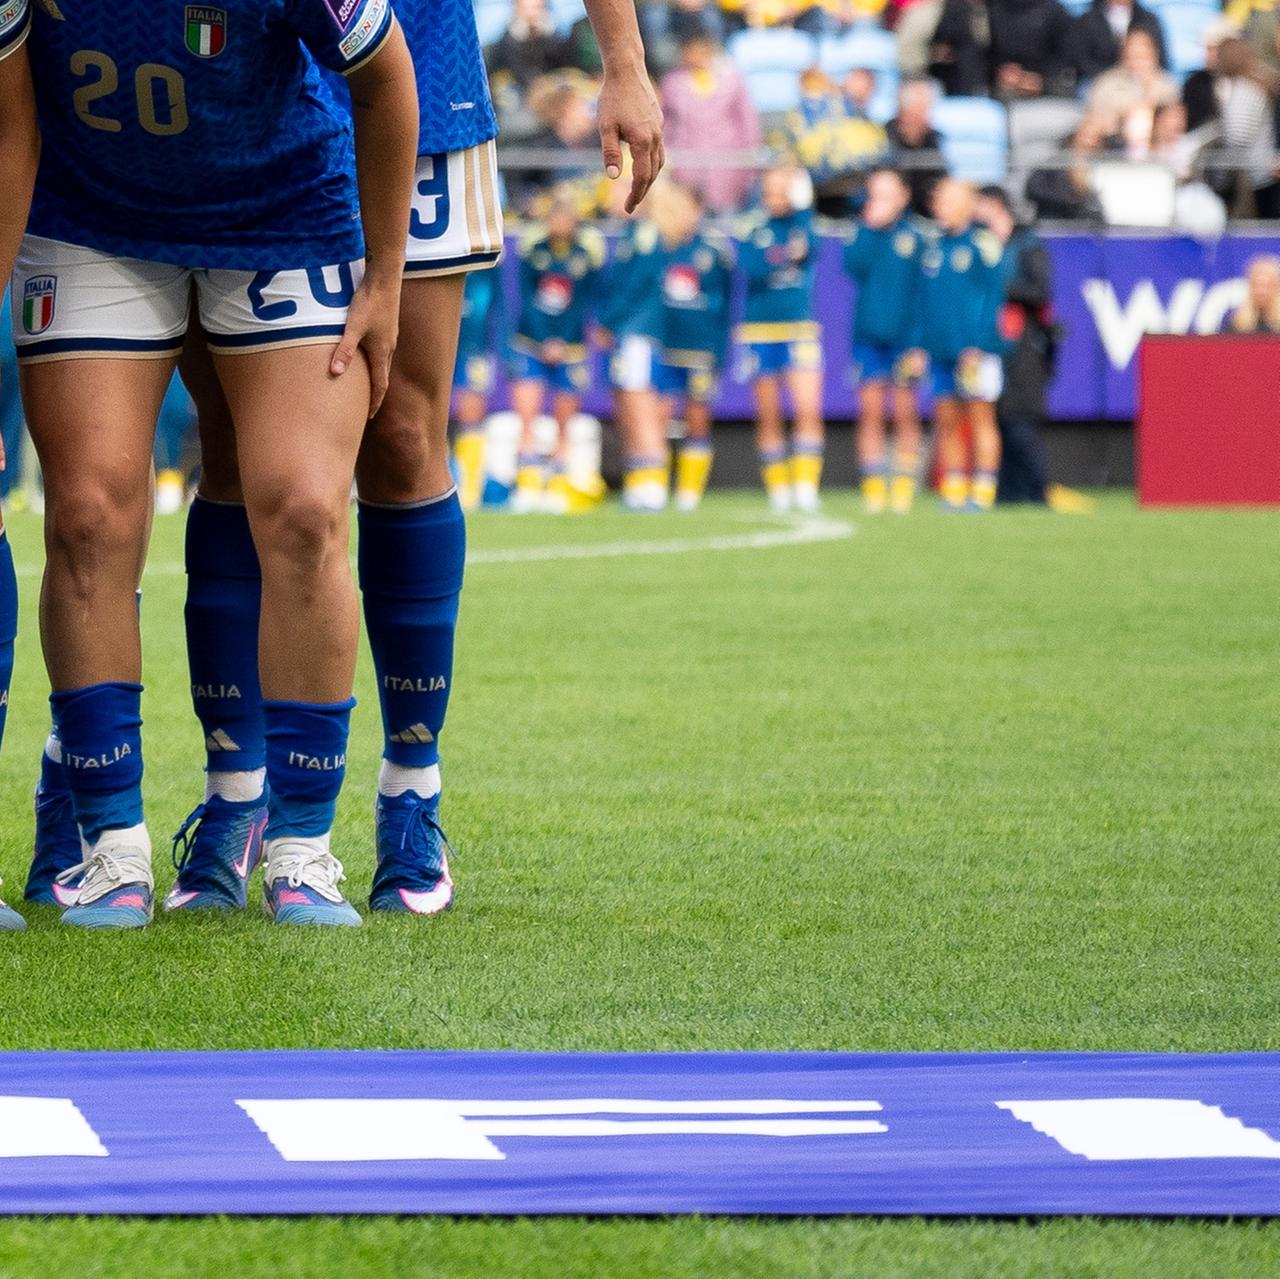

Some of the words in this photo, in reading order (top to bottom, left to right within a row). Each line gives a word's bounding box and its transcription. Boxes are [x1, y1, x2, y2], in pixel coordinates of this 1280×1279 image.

[187, 7, 224, 22] ITALIA
[68, 48, 190, 136] 20
[25, 279, 54, 294] ITALIA
[384, 675, 447, 693] ITALIA
[66, 742, 132, 771] ITALIA
[289, 751, 347, 772] ITALIA
